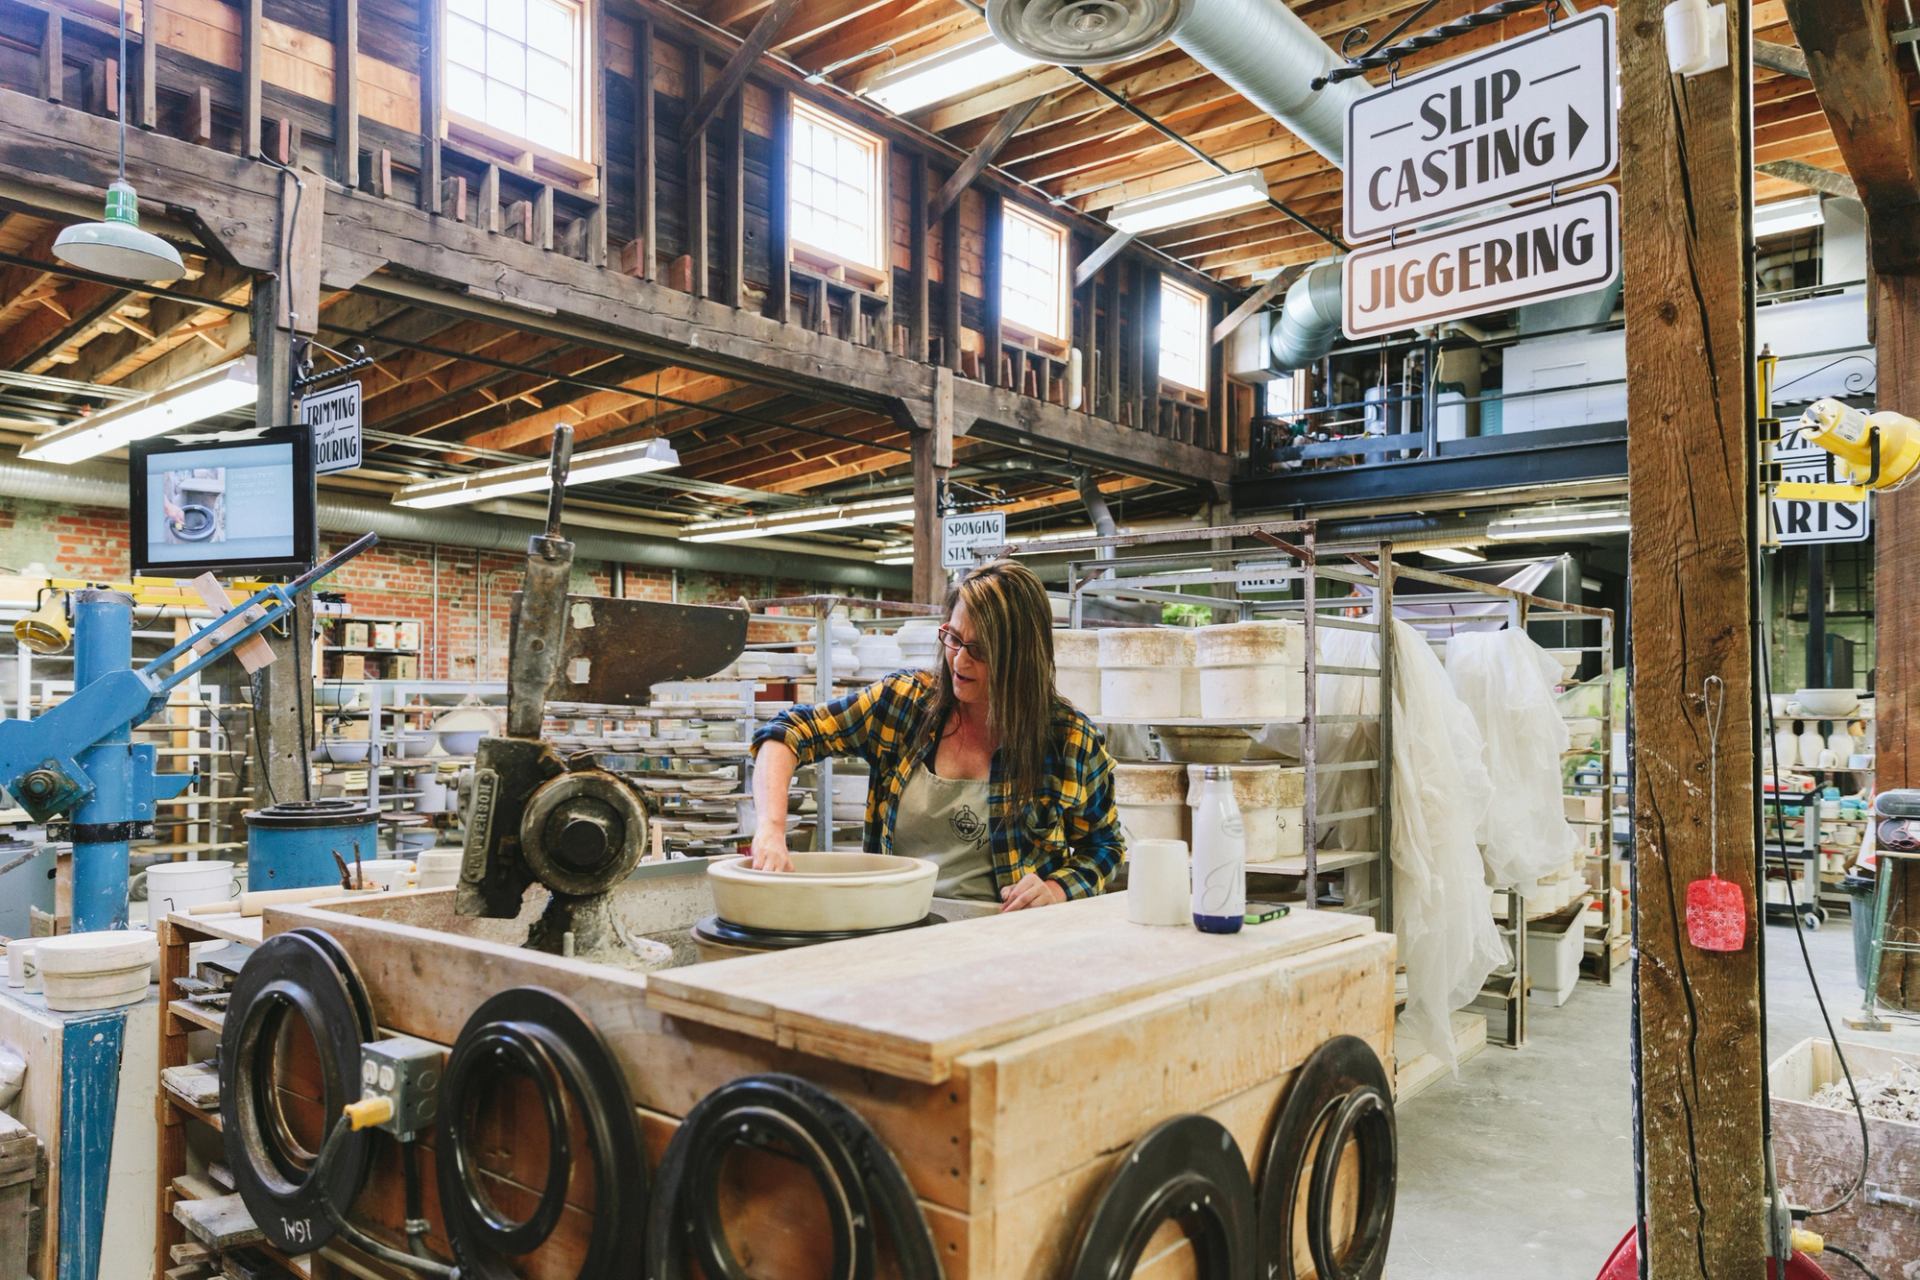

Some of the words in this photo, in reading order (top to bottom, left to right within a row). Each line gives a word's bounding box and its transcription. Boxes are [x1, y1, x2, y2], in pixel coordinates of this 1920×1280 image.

[1420, 69, 1521, 142] SLIP
[1368, 116, 1555, 211] CASTING
[1359, 218, 1594, 313] JIGGERING
[307, 395, 355, 426] TRIMMING
[315, 436, 356, 465] LOURING
[948, 520, 999, 536] SPONGING
